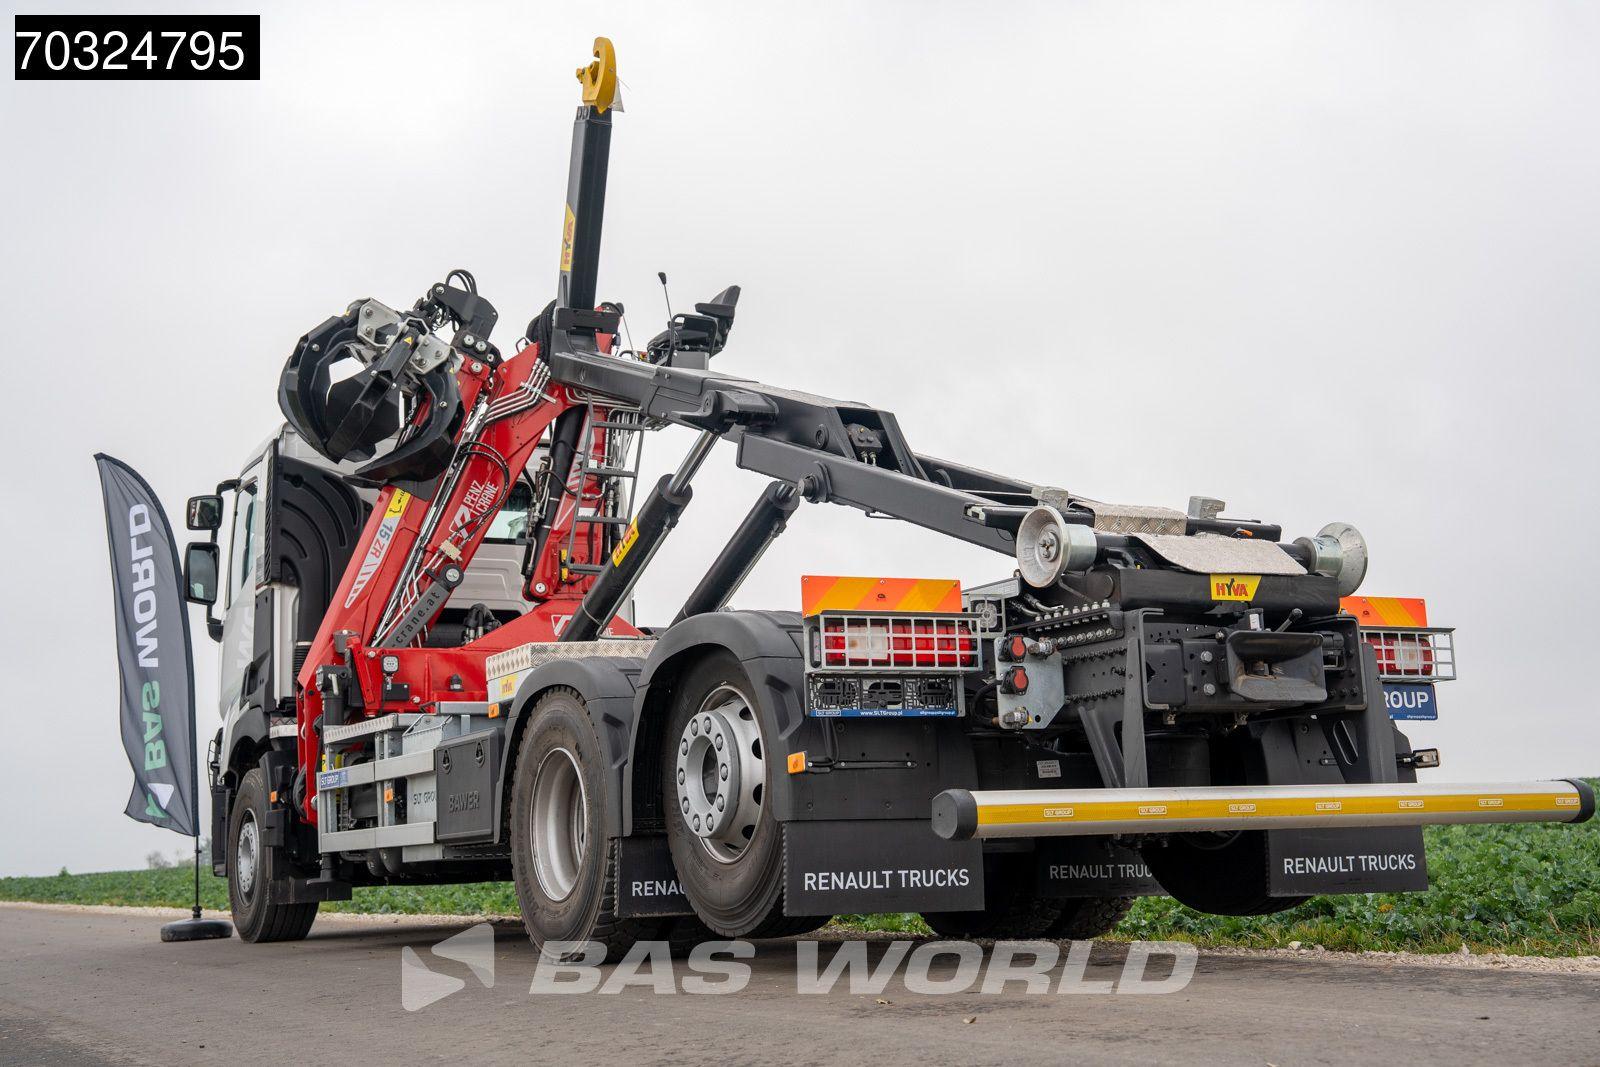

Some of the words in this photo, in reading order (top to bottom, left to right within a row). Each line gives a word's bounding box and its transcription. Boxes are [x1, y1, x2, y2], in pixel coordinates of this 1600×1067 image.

[463, 479, 485, 507] PENZ
[475, 481, 499, 513] CRANE
[379, 524, 393, 541] 15
[1215, 577, 1249, 596] HYVA
[449, 790, 480, 814] BAWER
[1049, 864, 1114, 879] RENAULT
[1283, 856, 1355, 874] RENAULT
[1358, 854, 1416, 871] TRUCKS
[804, 870, 893, 891] RENAULT
[897, 868, 970, 888] TRUCKS
